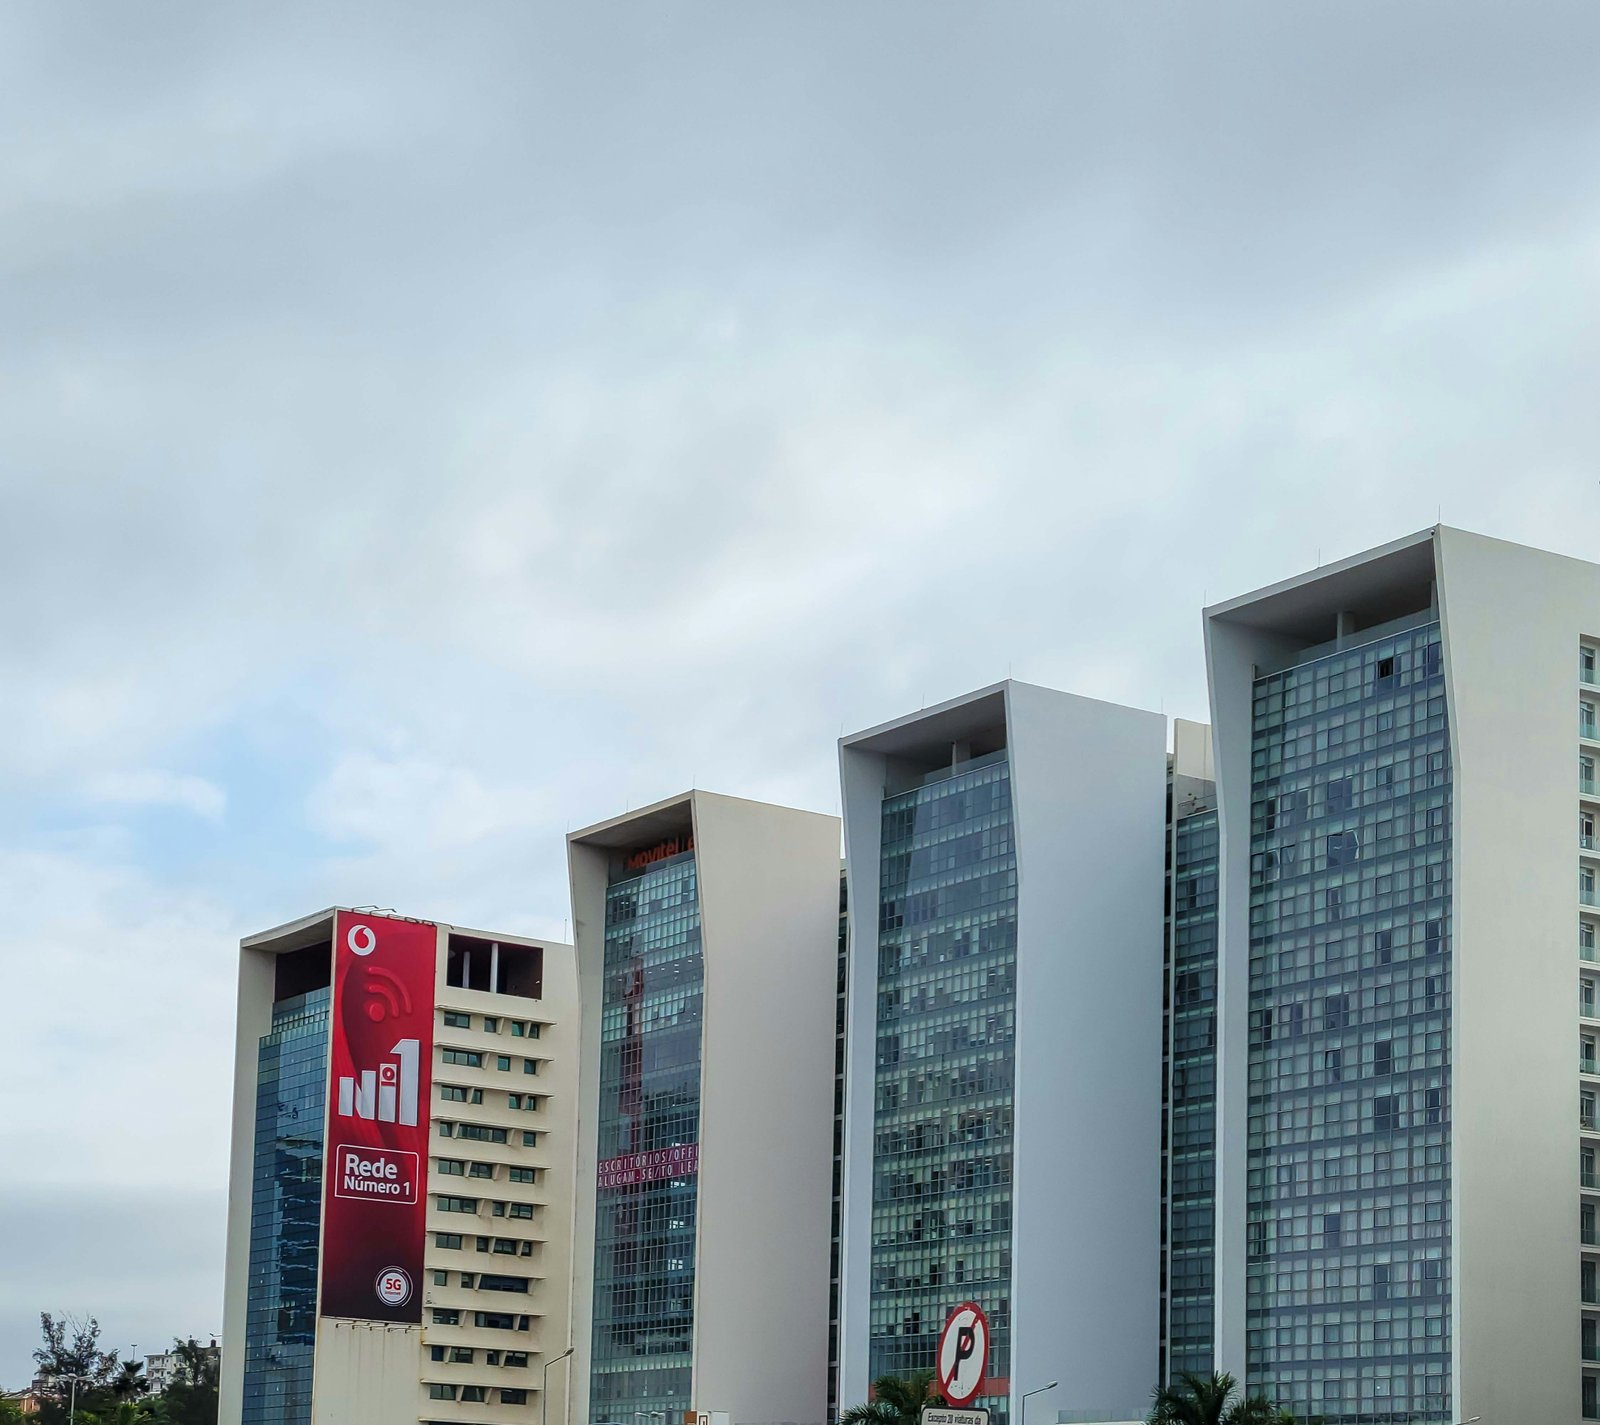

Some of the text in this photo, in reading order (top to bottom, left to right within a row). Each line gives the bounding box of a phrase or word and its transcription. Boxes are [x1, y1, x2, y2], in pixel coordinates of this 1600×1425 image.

[345, 1153, 398, 1179] Rede
[344, 1175, 410, 1196] Número 1
[385, 1278, 401, 1290] 5G
[953, 1327, 976, 1381] P
